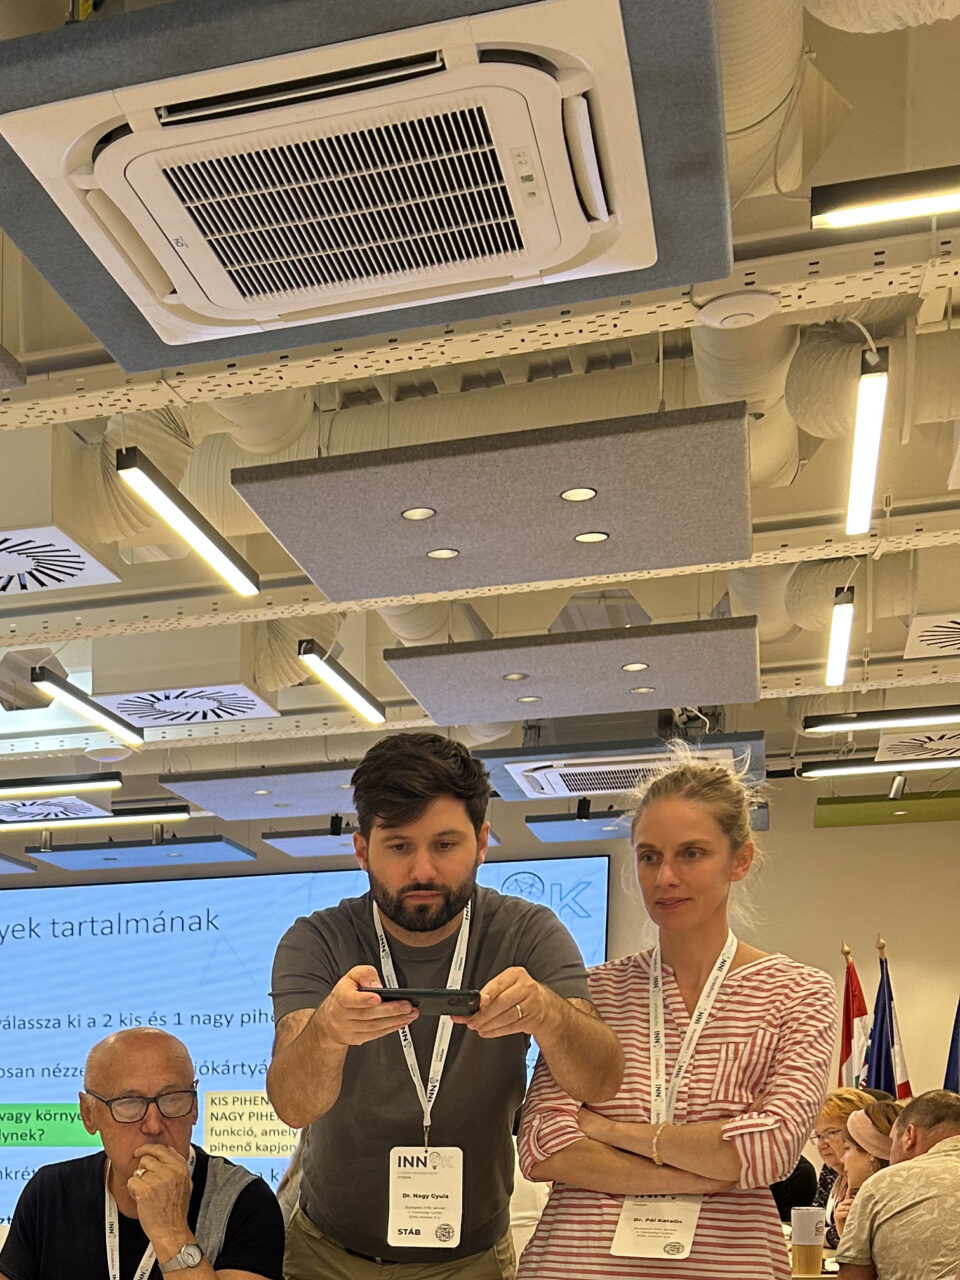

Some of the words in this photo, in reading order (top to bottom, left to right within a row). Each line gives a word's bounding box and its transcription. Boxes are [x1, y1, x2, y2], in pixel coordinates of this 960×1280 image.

[49, 908, 220, 938] tartalmának
[67, 1014, 81, 1028] ki
[87, 1018, 96, 1028] a
[102, 1013, 113, 1027] 2
[119, 1012, 142, 1027] kis
[148, 1011, 167, 1026] és
[173, 1011, 183, 1026] 1
[190, 1012, 234, 1028] nagy
[210, 1096, 229, 1106] KIS
[210, 1112, 245, 1122] NAGY
[210, 1126, 257, 1138] funkció,
[261, 1127, 298, 1139] amely
[209, 1142, 252, 1154] pihenő
[397, 1227, 421, 1236] STÁB
